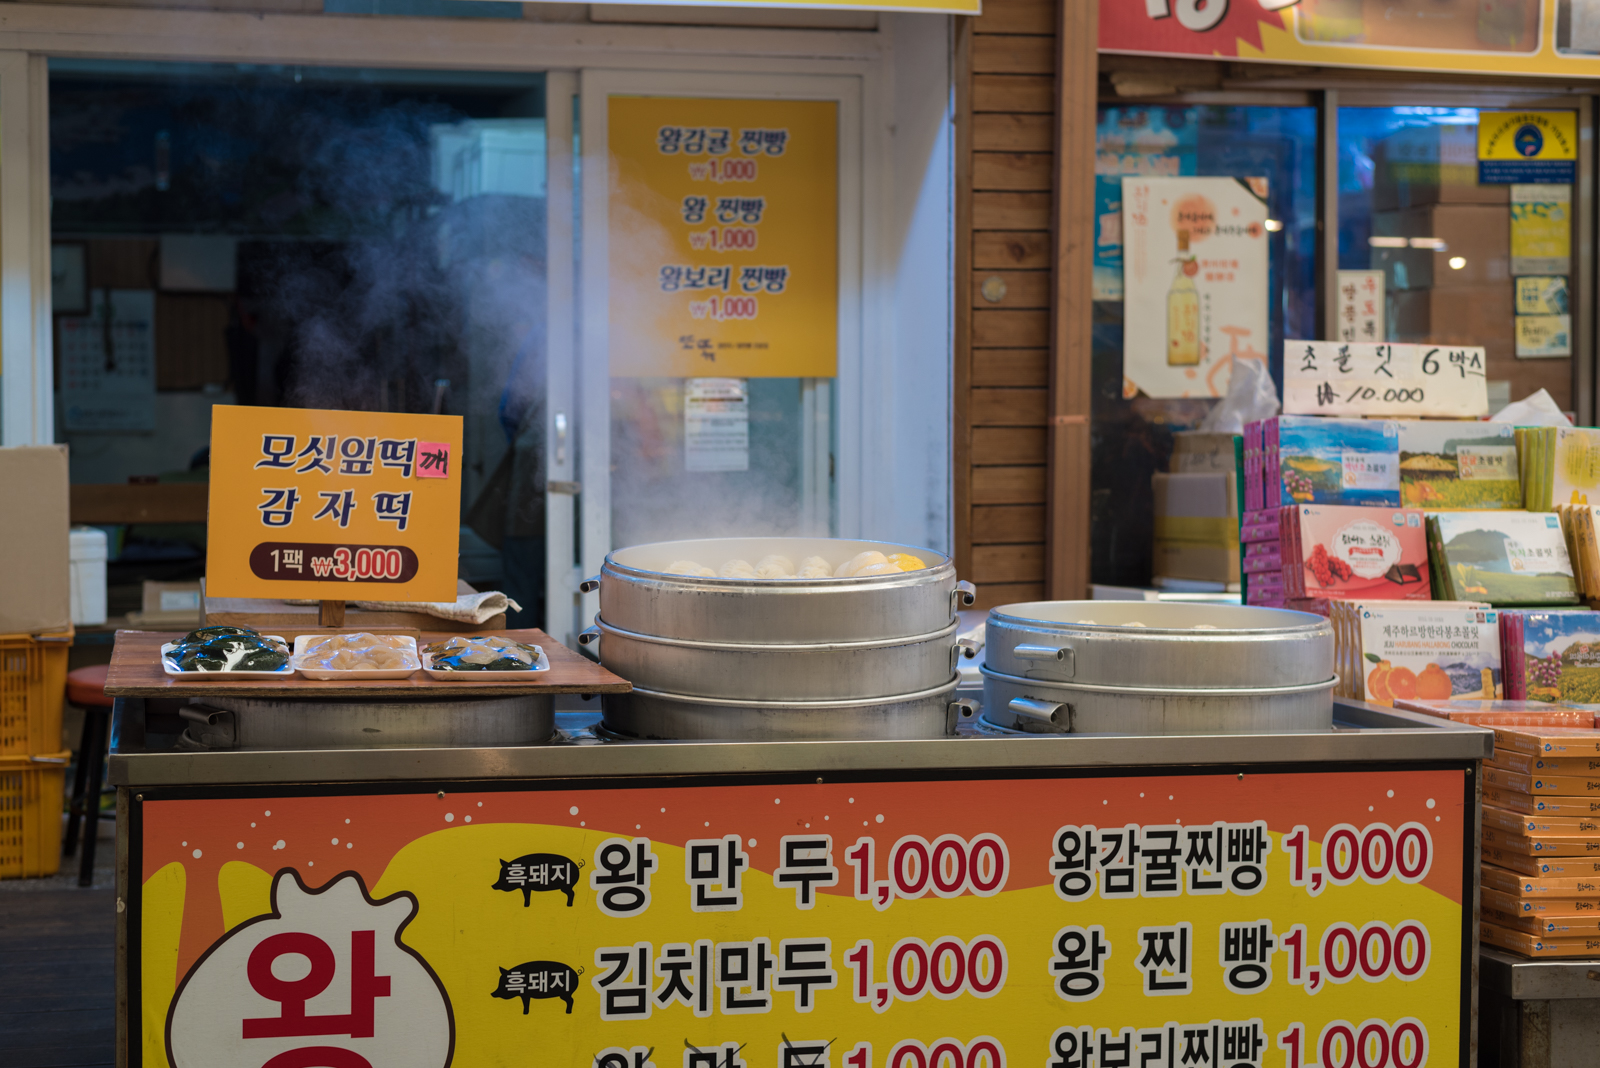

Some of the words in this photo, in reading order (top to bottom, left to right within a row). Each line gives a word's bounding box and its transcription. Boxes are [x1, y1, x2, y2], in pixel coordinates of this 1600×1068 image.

[657, 126, 731, 155] 왕감귤
[739, 128, 789, 157] 찐빵
[682, 195, 708, 224] 왕
[715, 197, 765, 225] 찐빵
[659, 265, 732, 293] 왕보리
[739, 266, 789, 294] 찐빵
[1421, 347, 1441, 375] 6
[254, 433, 417, 479] 모싯잎떡
[269, 548, 304, 574] 1팩
[1451, 641, 1480, 650] CHOCOLATE
[504, 862, 571, 886] 흑돼지
[849, 838, 1005, 906] 1,000
[1053, 825, 1268, 897] 왕감귤찐빵
[1285, 826, 1429, 892] 1,000
[1283, 924, 1427, 991] 1,000
[504, 969, 570, 993] 흑돼지
[596, 941, 833, 1016] 김치만두
[848, 939, 1004, 1009] 1,000
[1281, 1022, 1424, 1068] 1000
